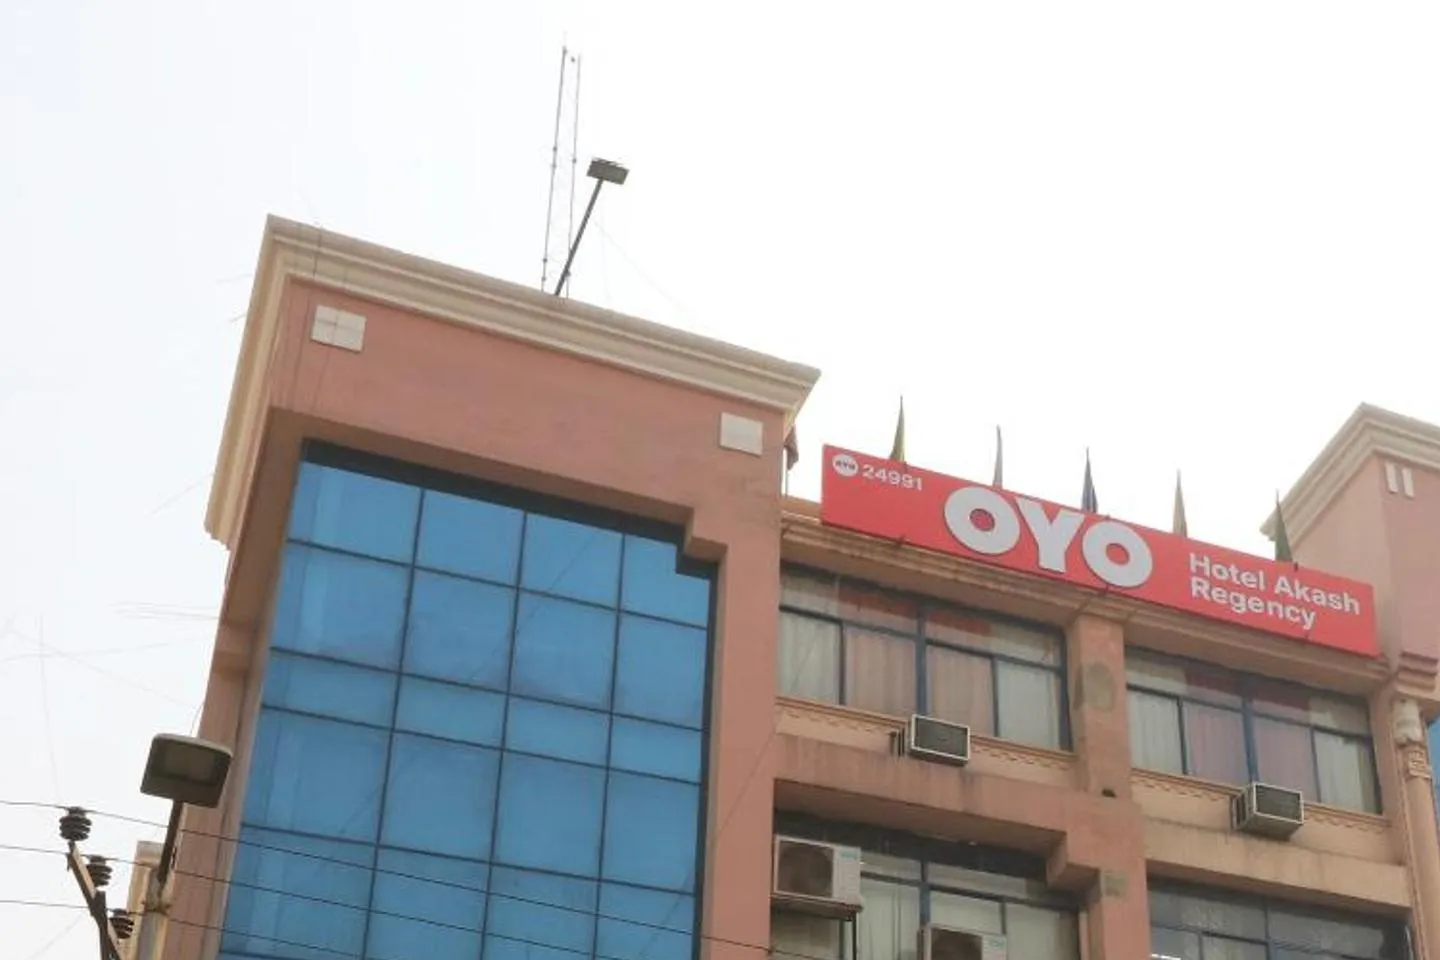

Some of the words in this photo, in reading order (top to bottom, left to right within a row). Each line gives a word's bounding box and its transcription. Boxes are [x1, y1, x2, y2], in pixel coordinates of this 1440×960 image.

[862, 463, 923, 491] 24991
[944, 486, 1153, 588] OYO
[1189, 552, 1266, 591] Hotel
[1274, 575, 1361, 616] Akash
[1190, 576, 1316, 630] Regency
